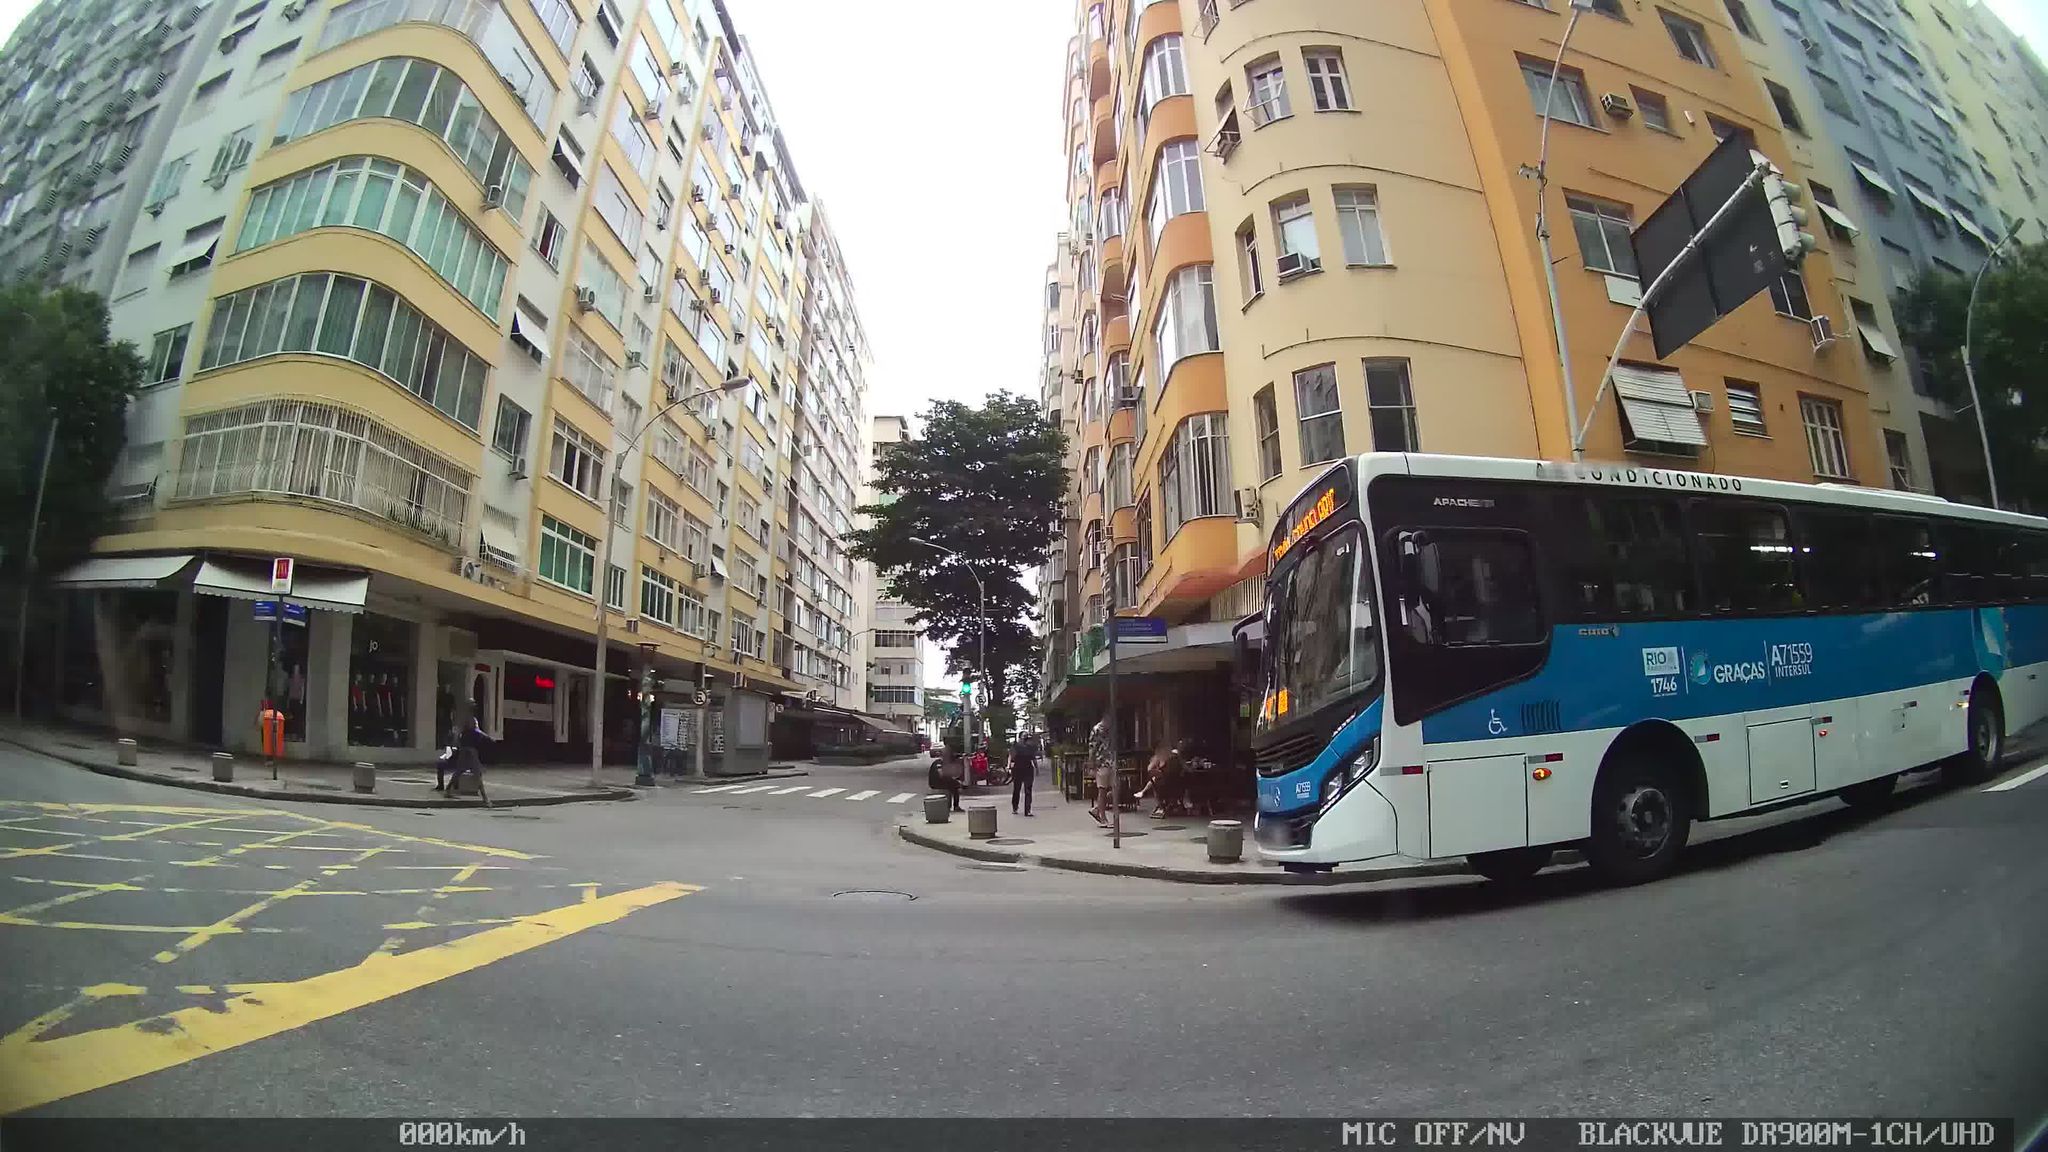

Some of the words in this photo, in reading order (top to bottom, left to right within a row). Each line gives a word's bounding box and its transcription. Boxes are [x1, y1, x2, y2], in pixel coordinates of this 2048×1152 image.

[1577, 467, 1742, 492] ONDICIONADO
[1645, 652, 1667, 666] RIO
[1771, 642, 1813, 667] A71559
[1713, 661, 1766, 684] GRAÇAS
[1774, 664, 1812, 678] INTERSUL
[1650, 676, 1678, 693] 1746
